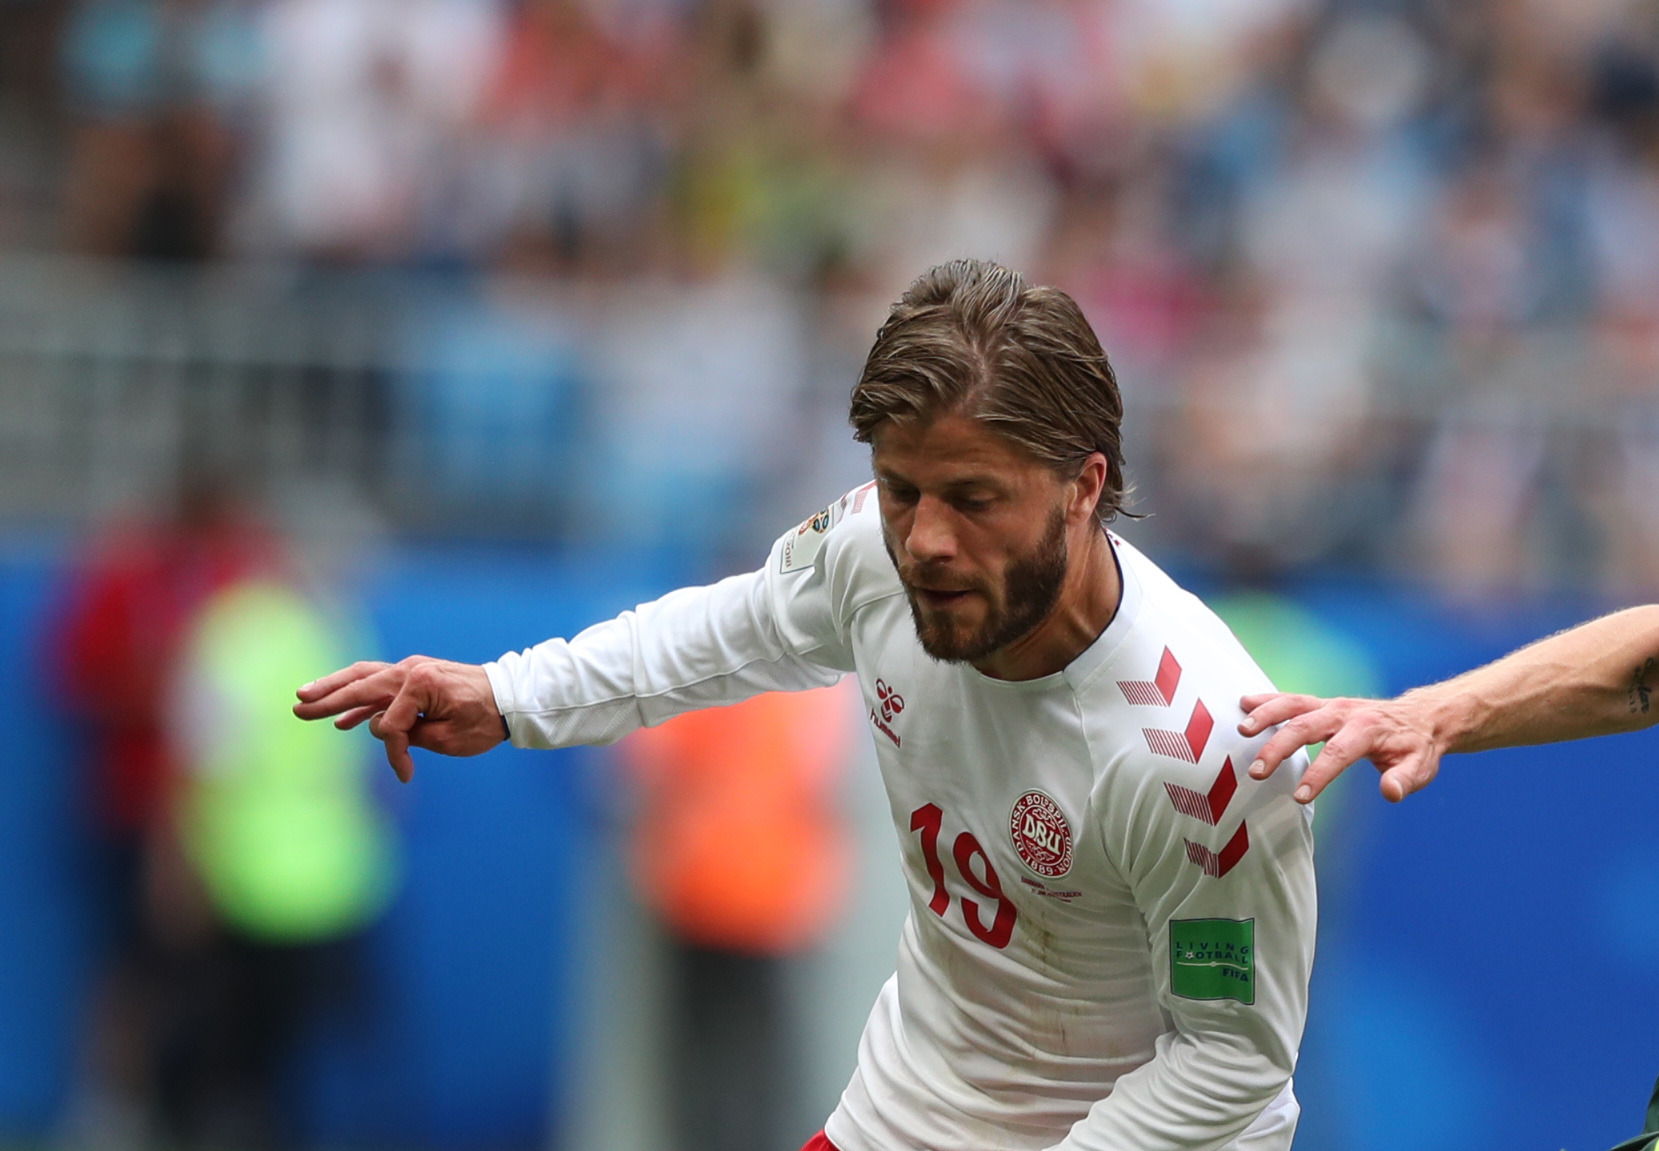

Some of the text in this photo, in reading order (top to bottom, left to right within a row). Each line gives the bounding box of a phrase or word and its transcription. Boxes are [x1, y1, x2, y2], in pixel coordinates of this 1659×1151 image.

[1022, 813, 1062, 856] DBU
[910, 802, 1017, 949] 19
[1025, 855, 1055, 876] 1889
[1175, 942, 1250, 955] LIVING
[1222, 968, 1249, 983] FIFA
